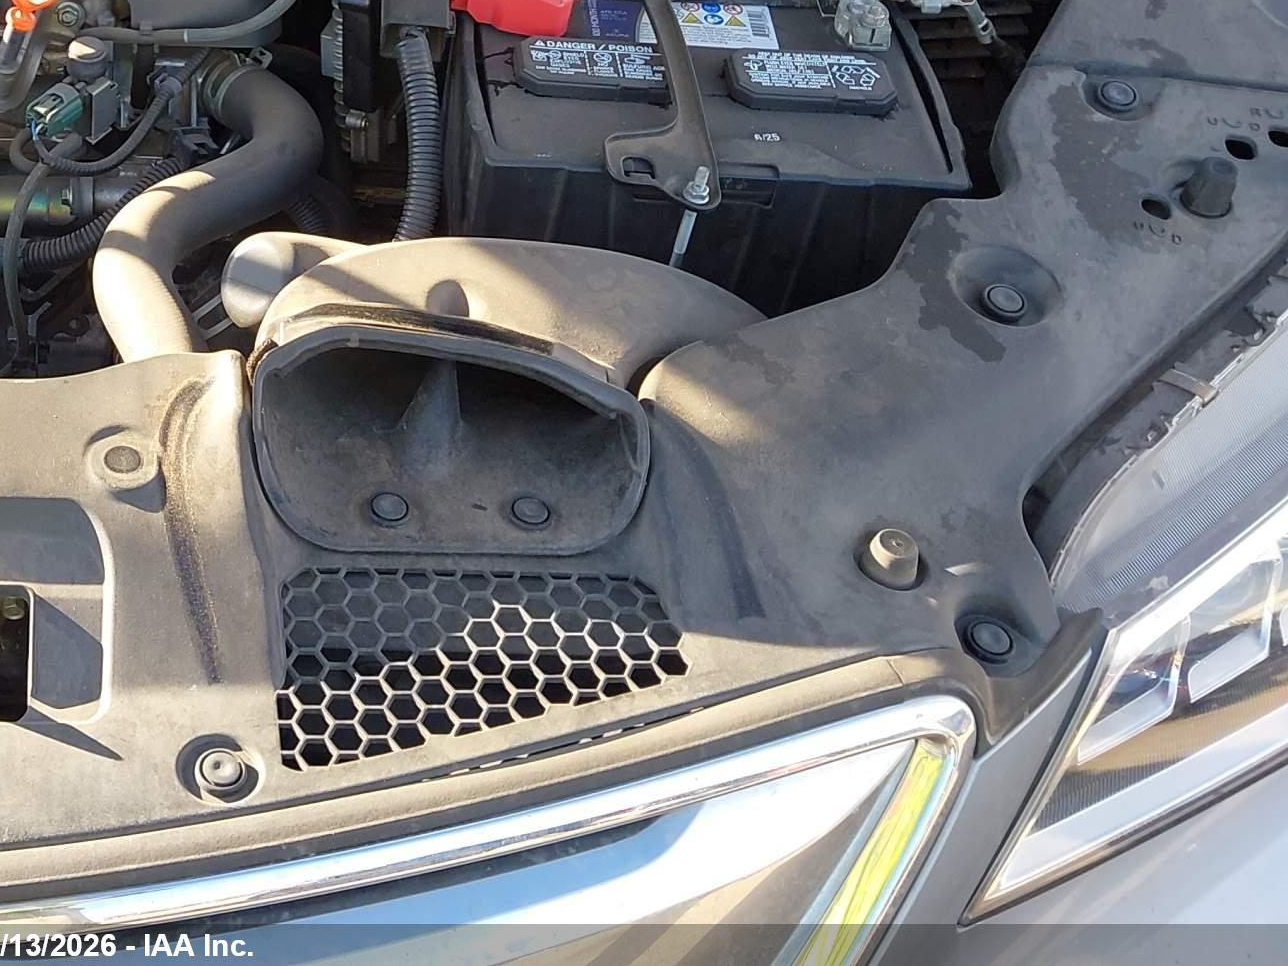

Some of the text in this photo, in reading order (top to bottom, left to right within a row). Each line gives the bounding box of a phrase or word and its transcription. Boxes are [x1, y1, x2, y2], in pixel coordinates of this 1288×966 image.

[546, 40, 653, 53] DANGER / POISON
